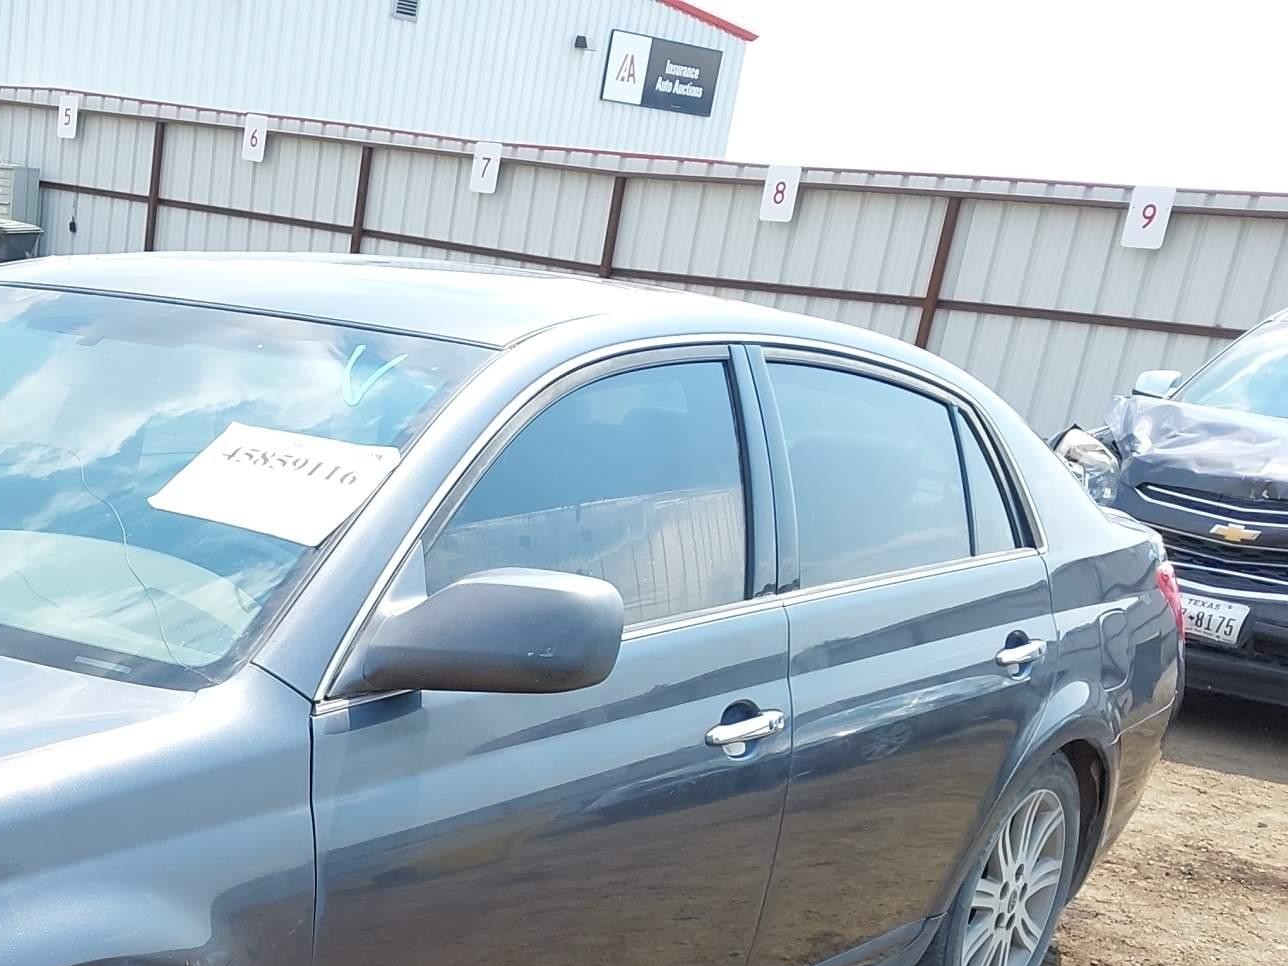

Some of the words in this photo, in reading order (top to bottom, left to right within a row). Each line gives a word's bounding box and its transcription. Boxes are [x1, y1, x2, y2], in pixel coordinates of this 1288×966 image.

[665, 59, 701, 80] Insurance
[655, 76, 673, 94] Auto
[672, 79, 704, 99] Auctions
[63, 107, 72, 126] 5
[250, 128, 258, 148] 6
[481, 157, 492, 178] 7
[773, 181, 787, 205] 8
[1142, 203, 1157, 229] 9
[1187, 598, 1222, 611] TEXAS
